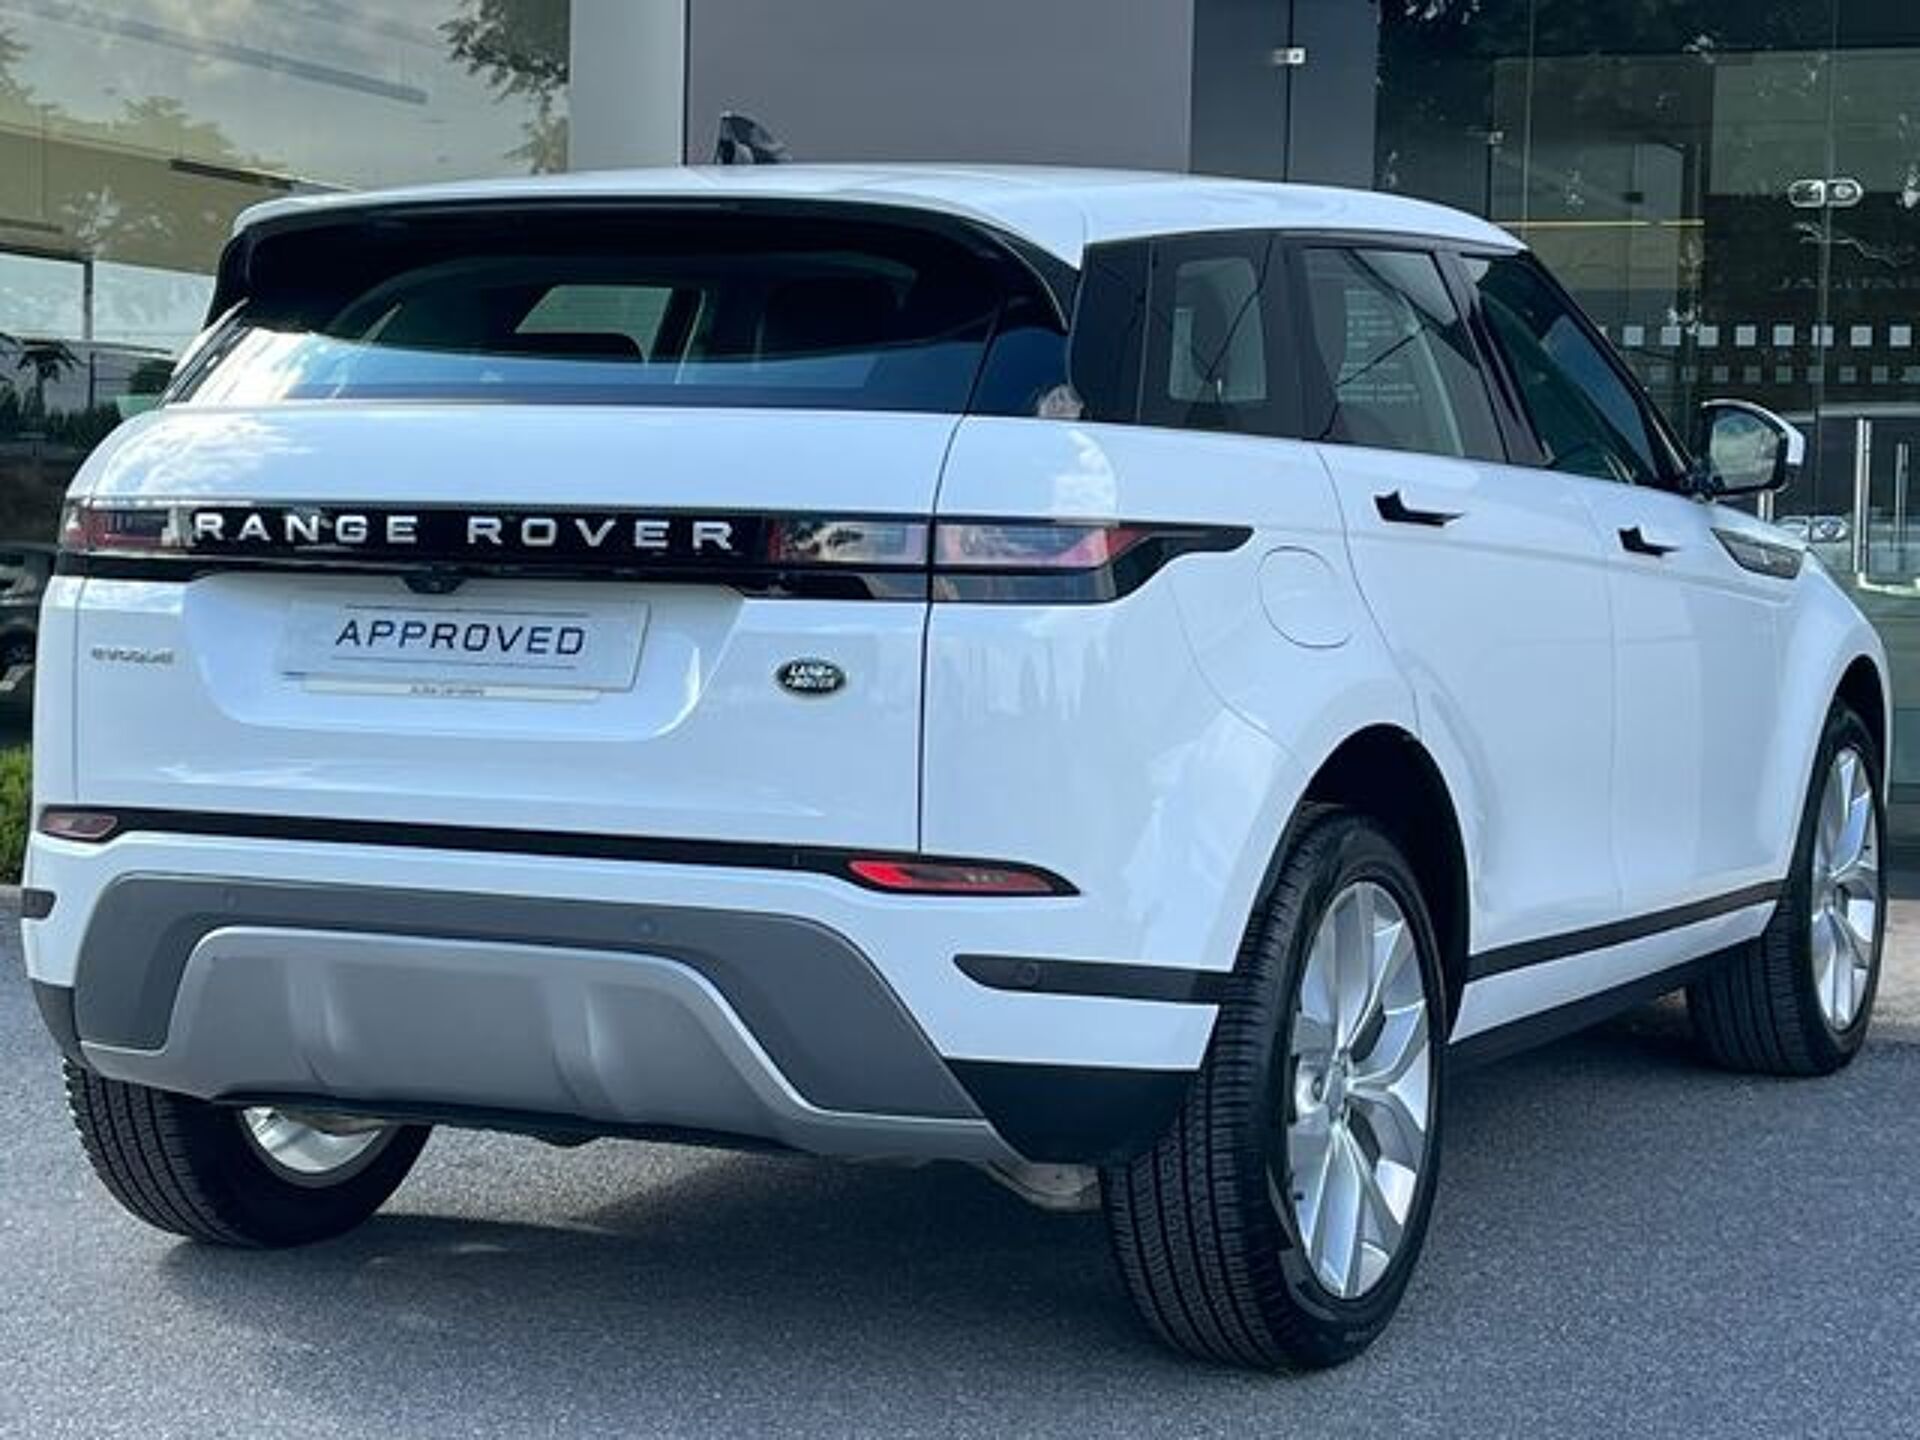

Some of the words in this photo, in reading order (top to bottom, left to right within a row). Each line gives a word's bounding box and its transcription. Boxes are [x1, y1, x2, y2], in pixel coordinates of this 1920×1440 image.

[194, 512, 419, 544] RANGE
[466, 515, 734, 551] ROVER
[334, 619, 586, 656] APPROVED
